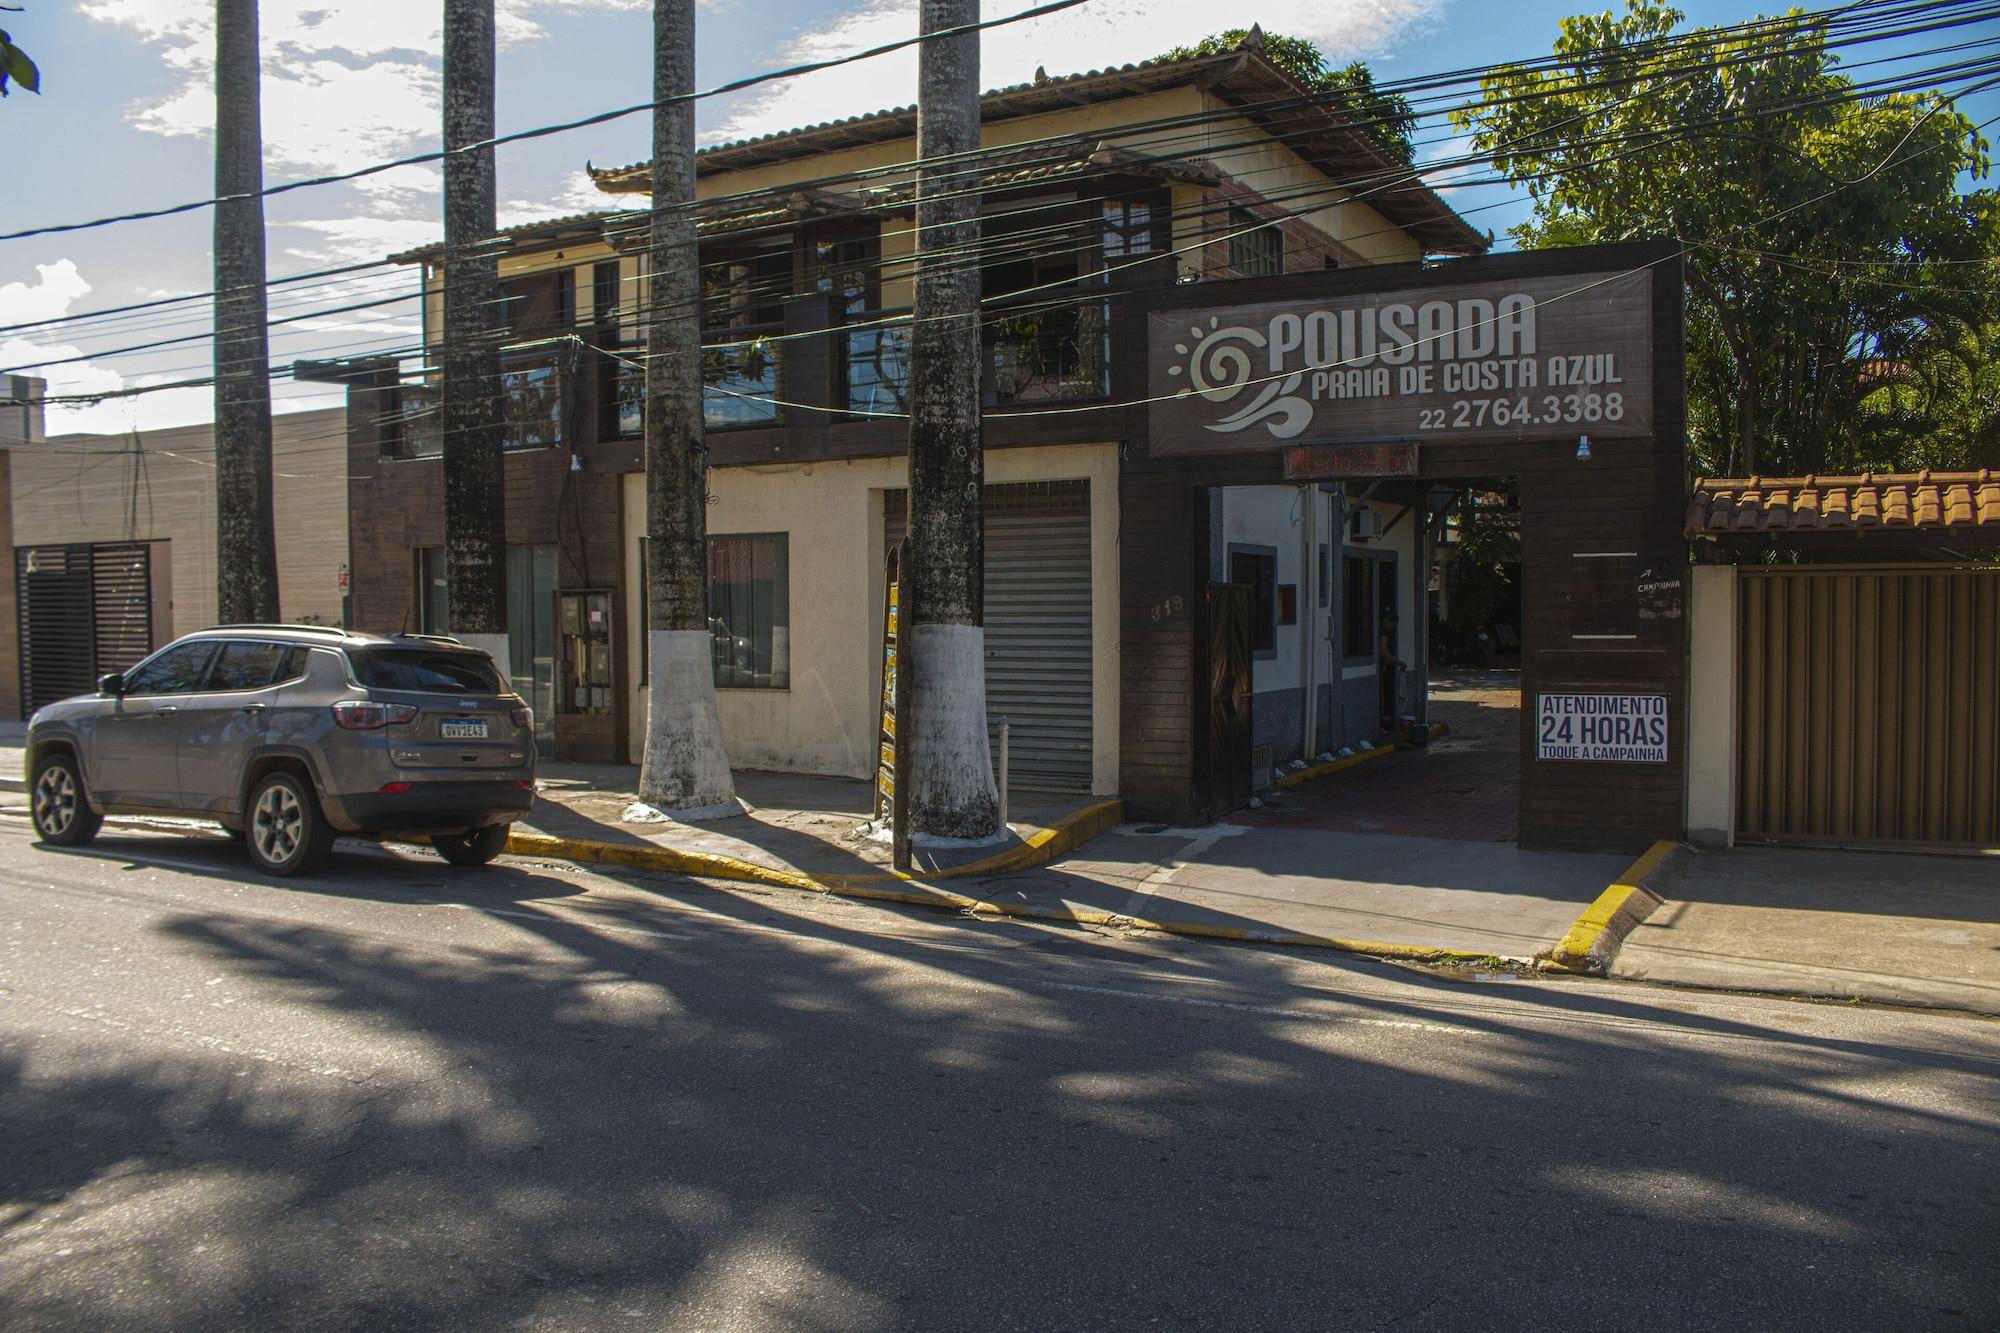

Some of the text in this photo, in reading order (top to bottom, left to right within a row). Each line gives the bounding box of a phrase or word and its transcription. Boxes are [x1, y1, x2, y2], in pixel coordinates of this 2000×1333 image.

[1268, 294, 1536, 372] POUSADA
[1312, 353, 1622, 400] PRAIA DE COSTA AZUL
[1418, 392, 1624, 430] 22 2764.3388
[1543, 696, 1664, 715] ATENDIMENTO
[1541, 716, 1664, 746] 24 HORAS
[1542, 746, 1664, 760] TOQUE A CAMPAINHA
